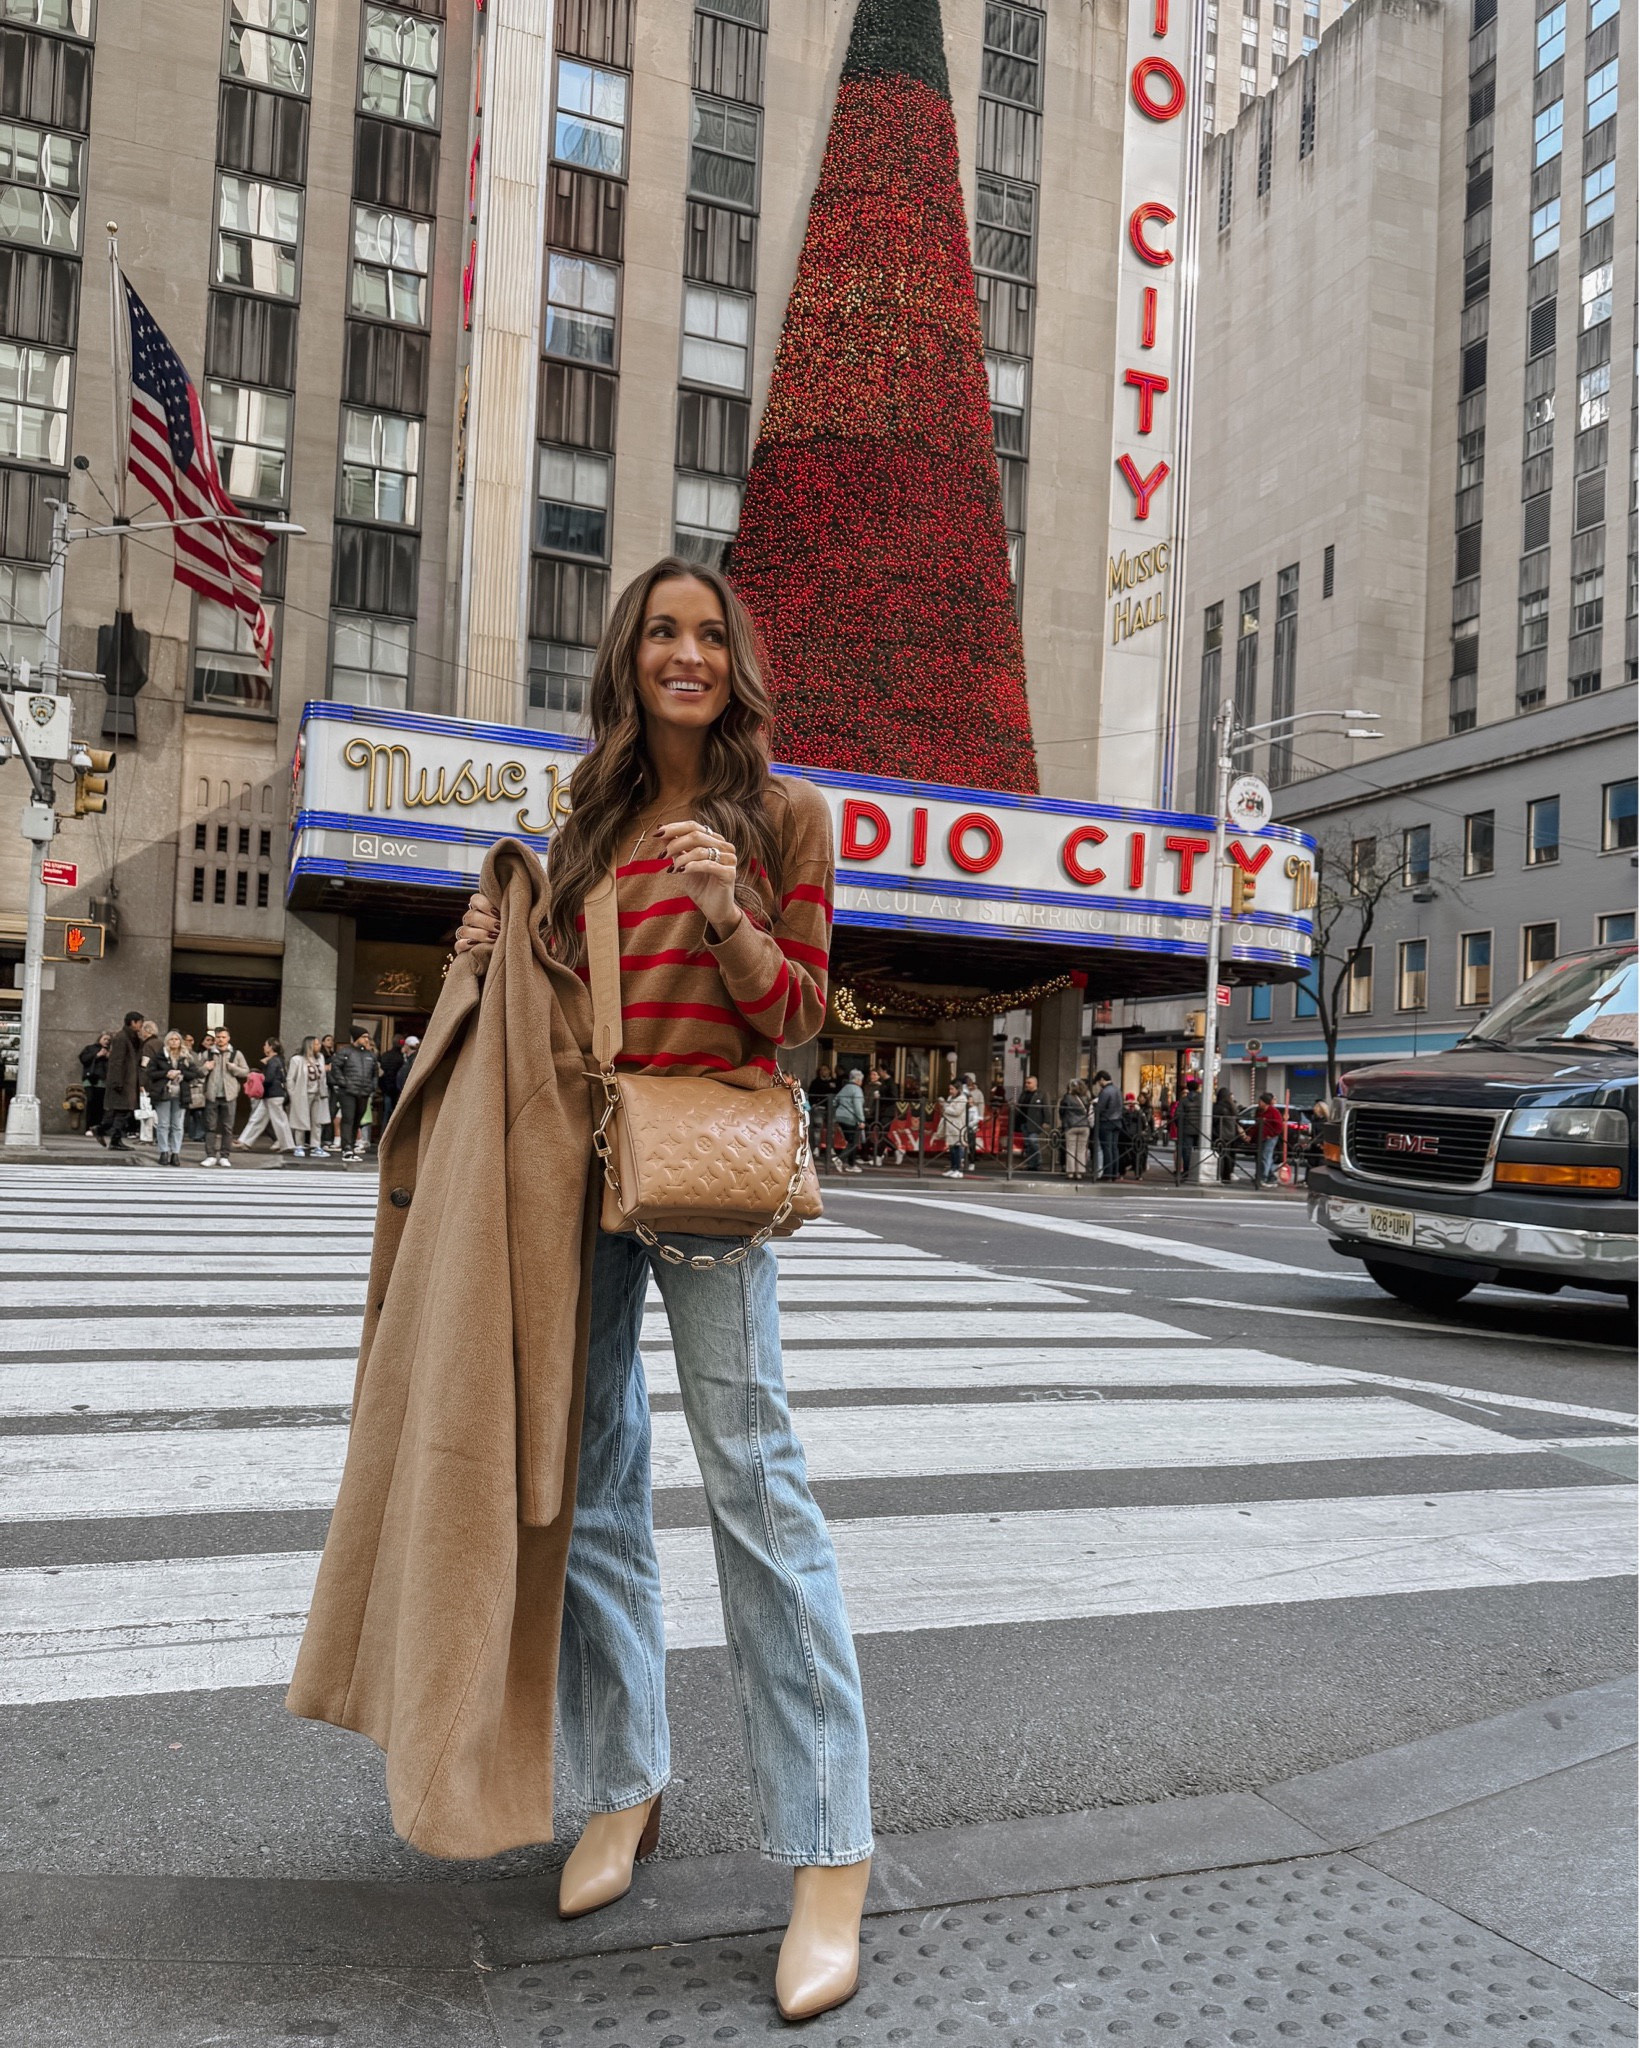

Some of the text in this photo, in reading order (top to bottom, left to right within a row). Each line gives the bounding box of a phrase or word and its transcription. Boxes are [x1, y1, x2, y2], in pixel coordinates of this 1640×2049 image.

[1117, 202, 1176, 520] CITY
[1112, 592, 1166, 645] HALL
[381, 842, 418, 857] QVC
[1063, 823, 1273, 893] CITY
[979, 900, 1103, 930] STARRING
[1126, 913, 1163, 937] THE
[1386, 1133, 1439, 1154] GMC
